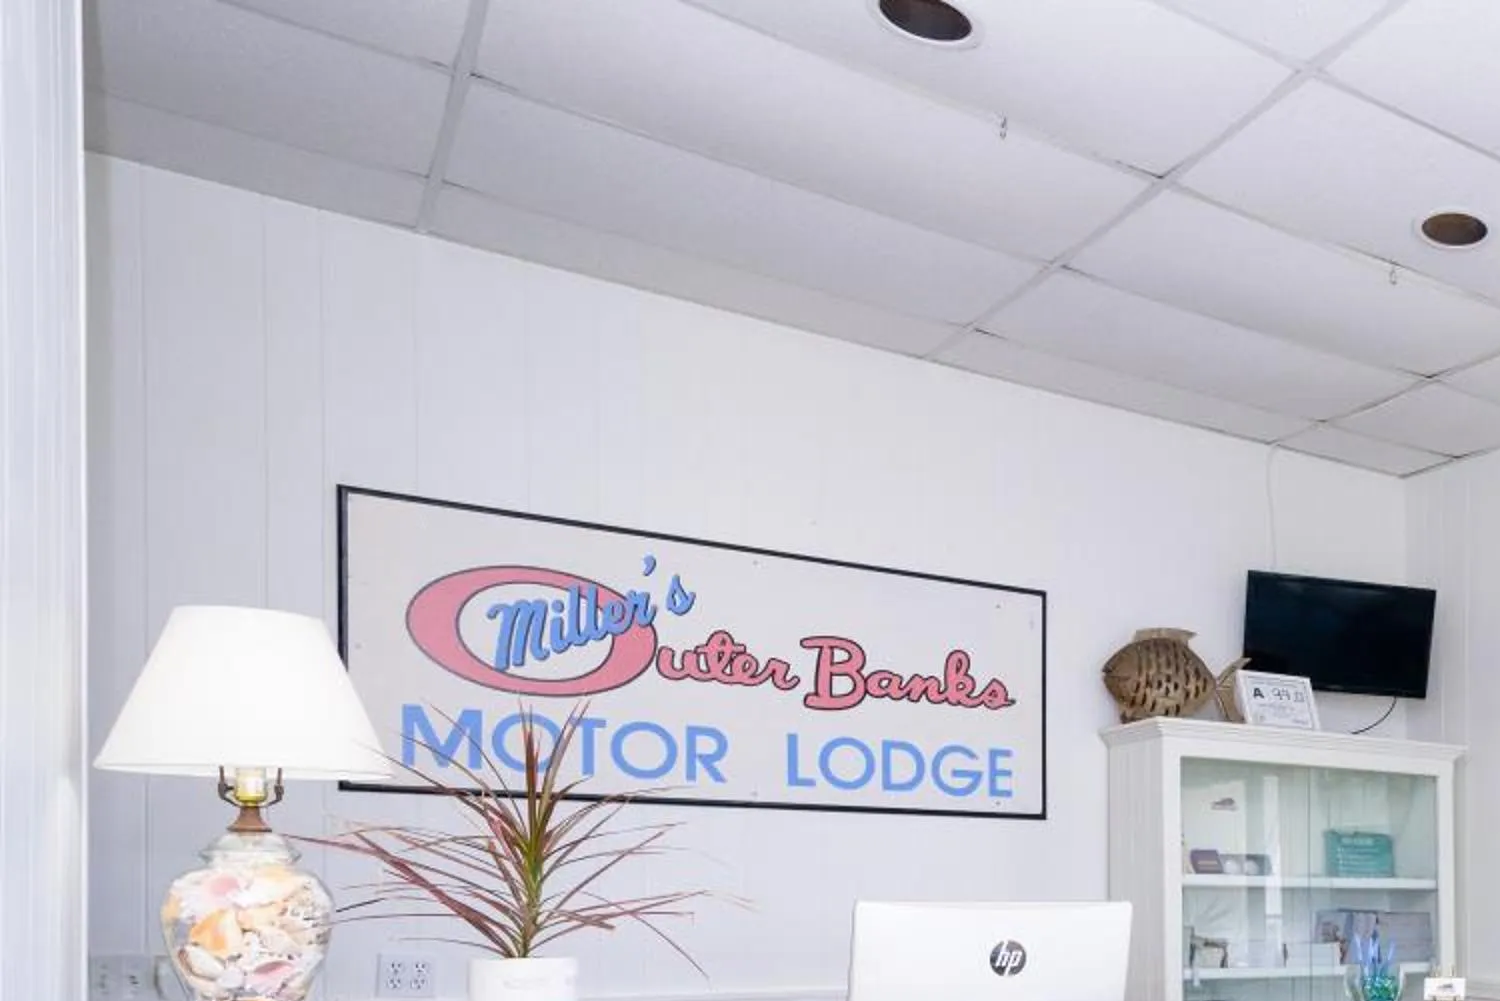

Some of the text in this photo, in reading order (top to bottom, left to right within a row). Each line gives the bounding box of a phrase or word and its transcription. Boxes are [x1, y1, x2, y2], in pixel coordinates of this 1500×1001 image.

[405, 564, 1016, 710] Outer Banks
[487, 554, 696, 672] Miller's
[401, 703, 1013, 799] MOTOR LODGE
[995, 940, 1023, 977] hp
